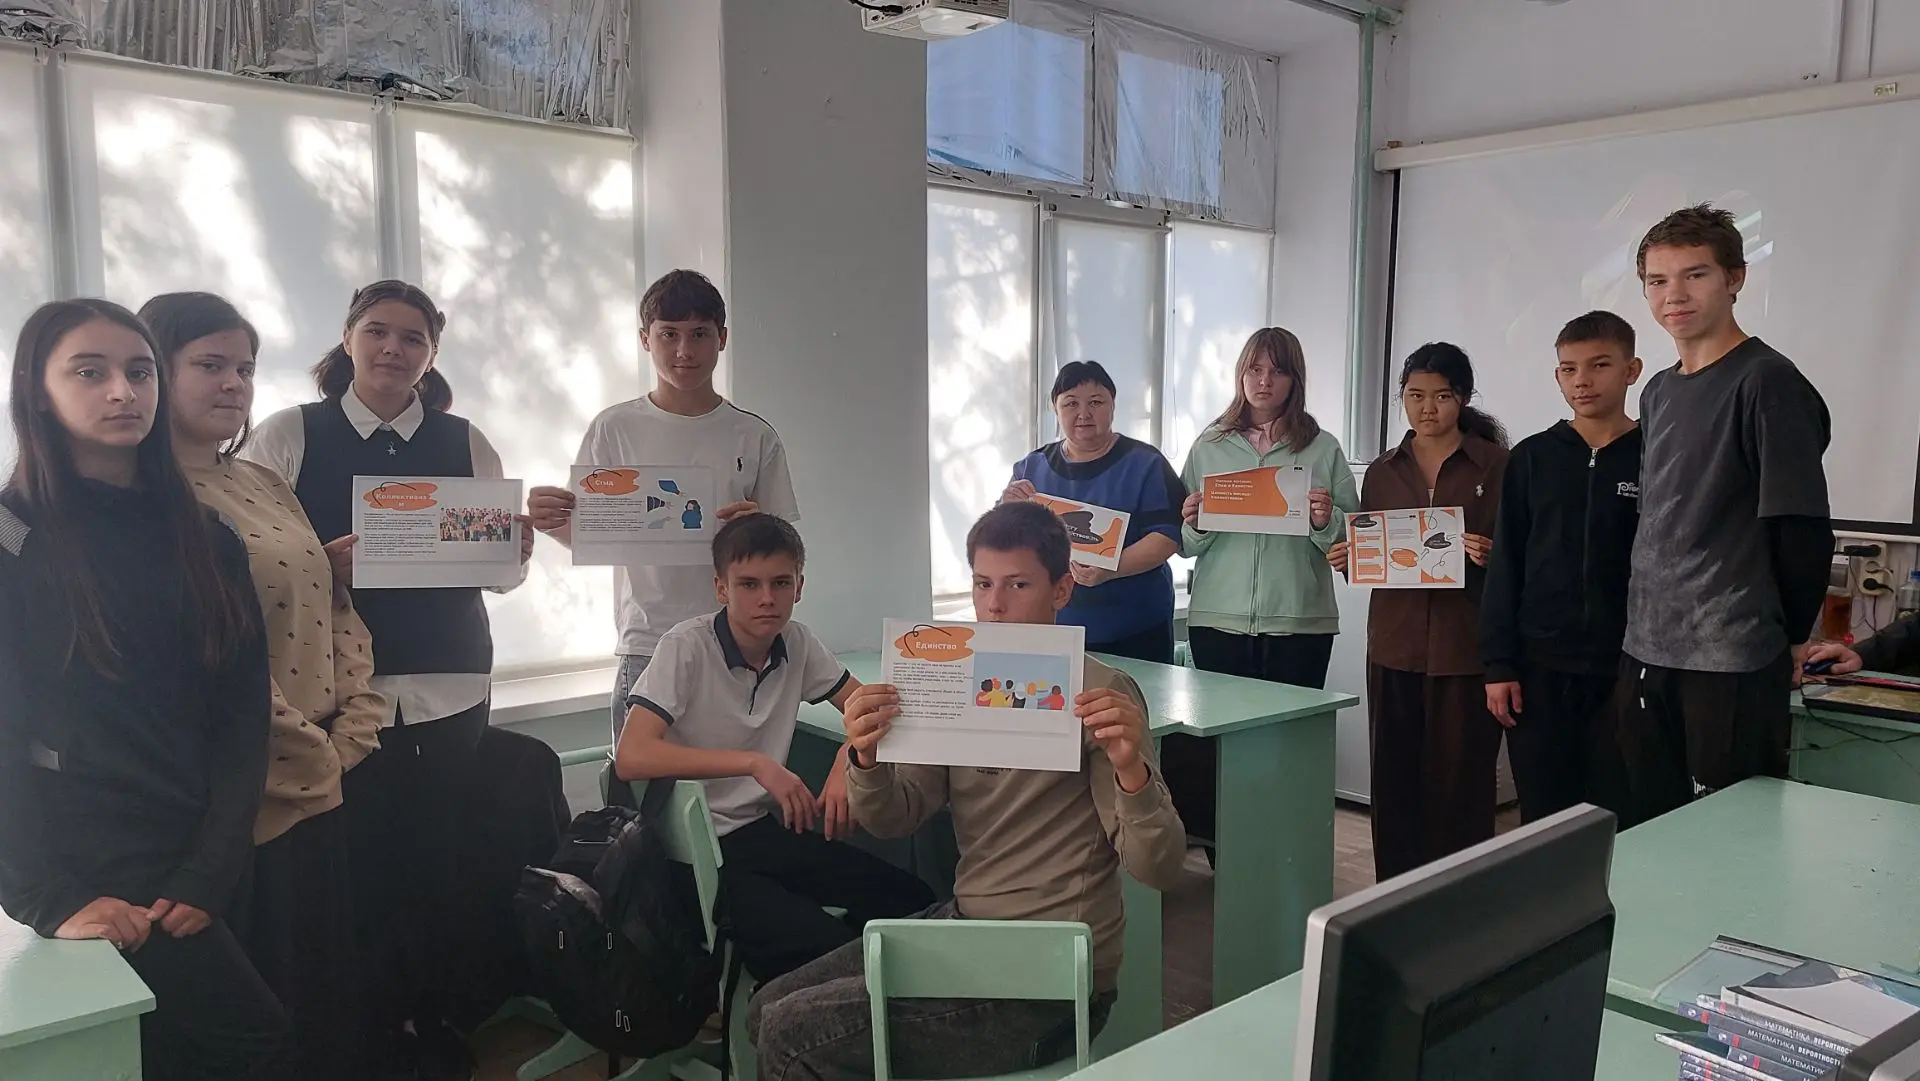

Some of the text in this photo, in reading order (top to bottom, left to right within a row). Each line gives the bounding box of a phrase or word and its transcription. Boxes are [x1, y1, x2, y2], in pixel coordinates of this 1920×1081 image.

[915, 641, 957, 650] Единство
[1747, 1028, 1795, 1051] МАТЕМАТИКА
[1763, 1020, 1854, 1055] МАТЕМАТИКА ВЕРОЯТНОСТ
[1780, 1054, 1825, 1075] МАТЕМАТИК
